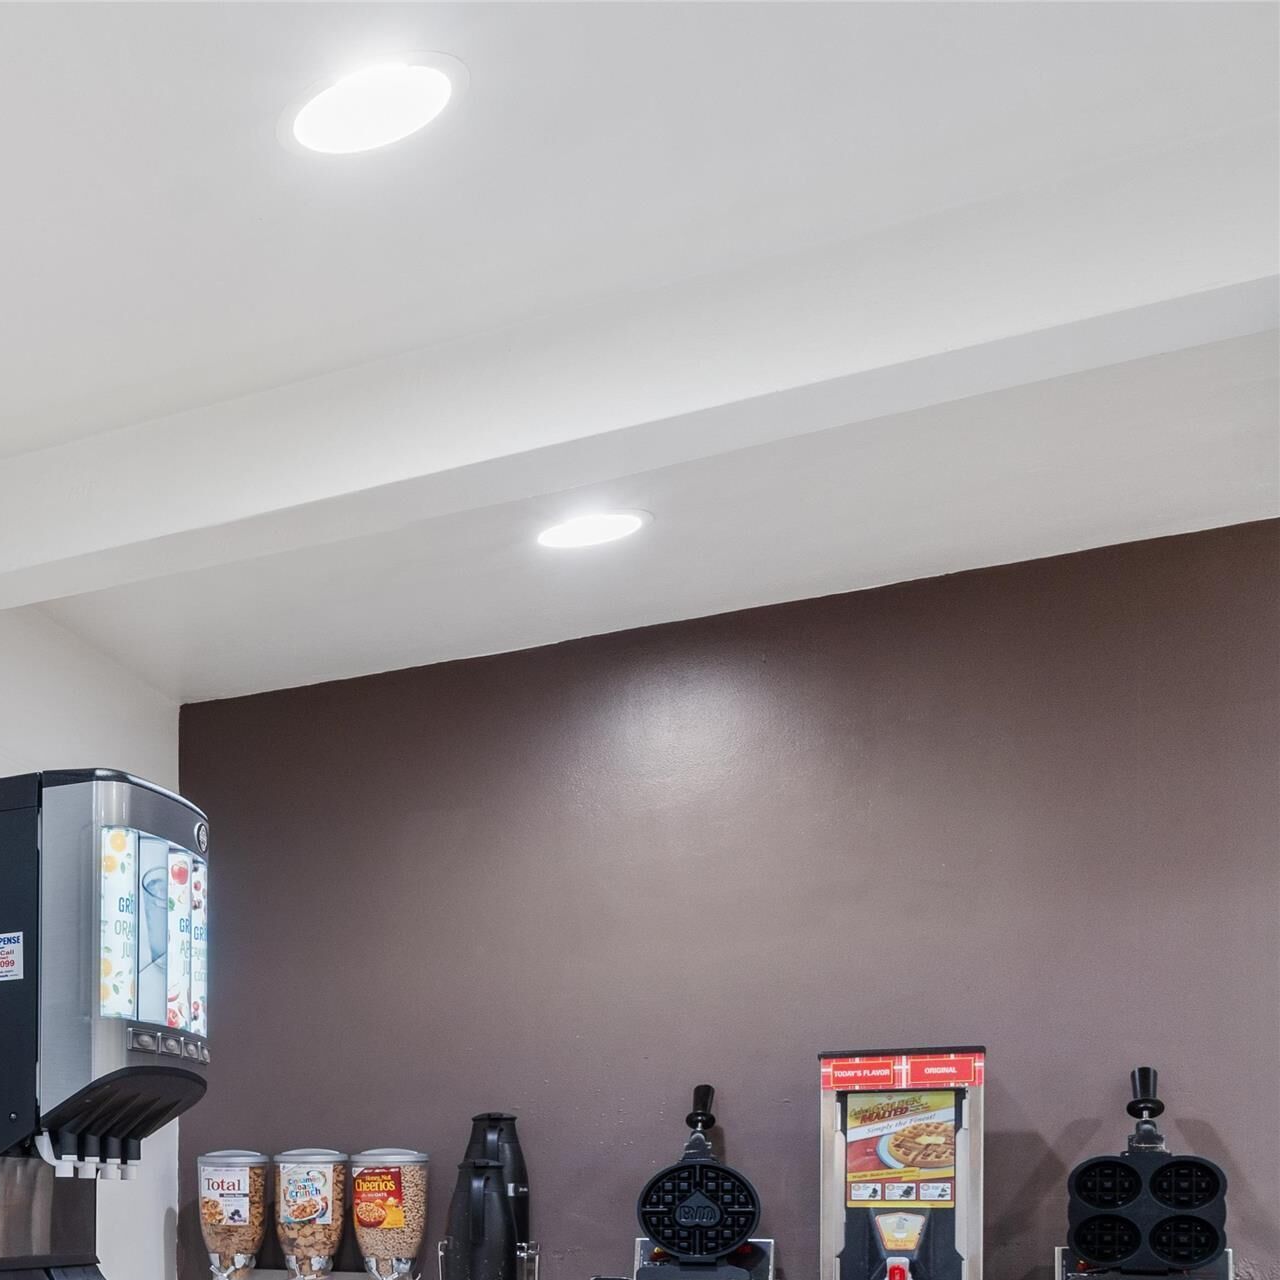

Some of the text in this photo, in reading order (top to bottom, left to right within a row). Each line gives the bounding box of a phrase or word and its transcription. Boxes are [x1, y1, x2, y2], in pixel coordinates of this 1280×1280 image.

[866, 1123, 893, 1134] Simply
[894, 1120, 907, 1128] the
[205, 1178, 240, 1191] Total
[355, 1180, 395, 1191] Cheerios
